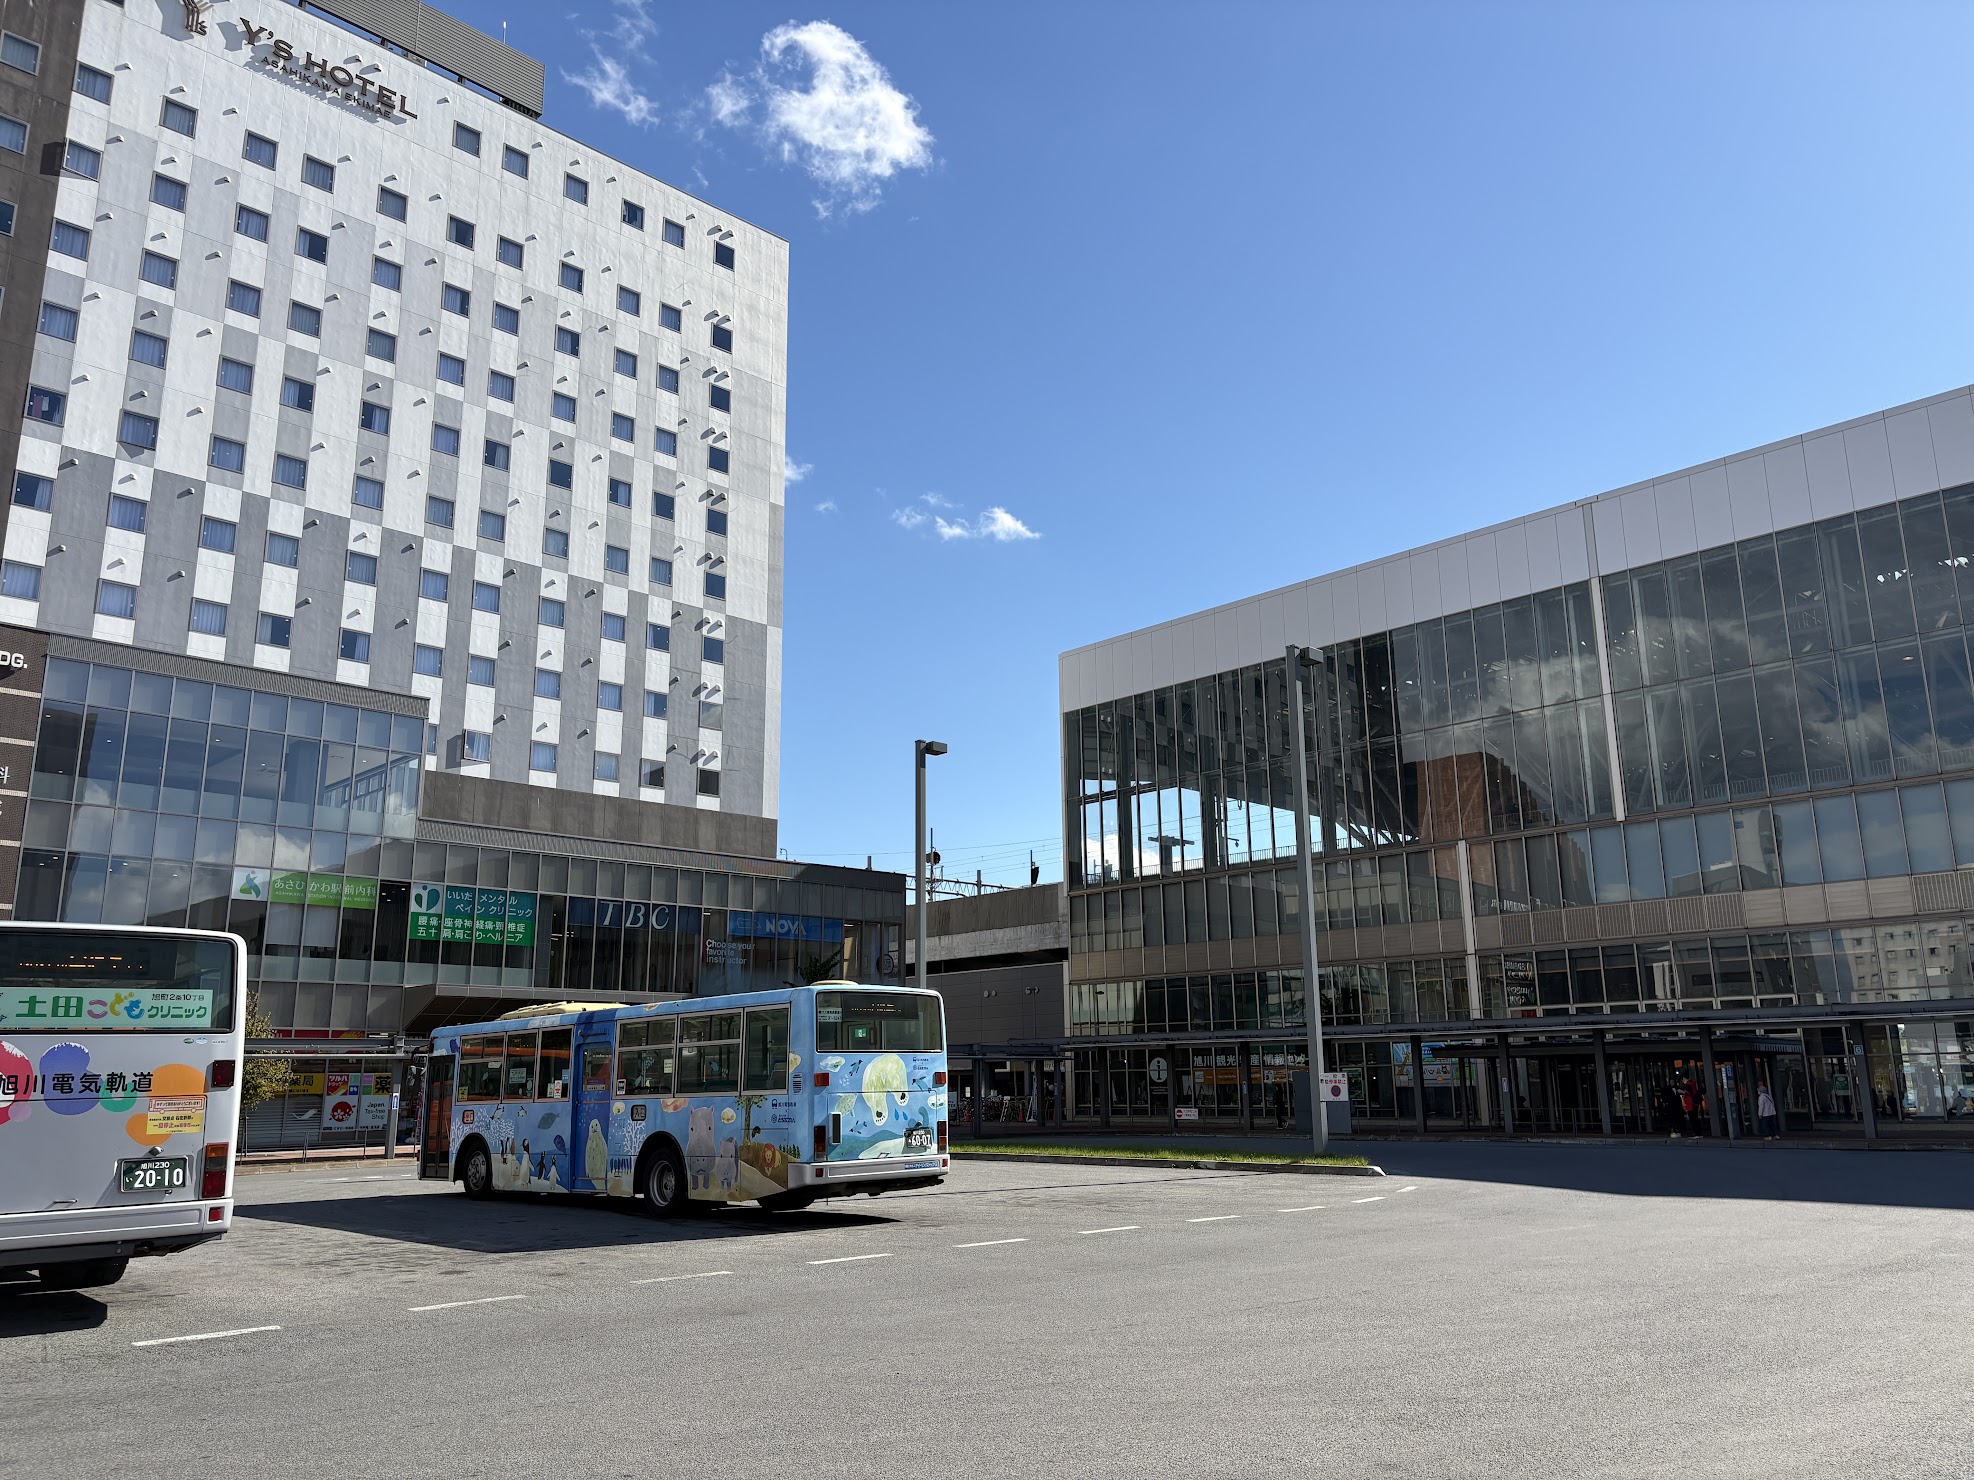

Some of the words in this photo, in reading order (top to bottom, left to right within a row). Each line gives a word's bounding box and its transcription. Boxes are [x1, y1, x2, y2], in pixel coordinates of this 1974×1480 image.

[261, 56, 340, 96] ASAHIKAWA
[344, 92, 391, 119] EKIMAE
[304, 51, 418, 120] HOTEL
[274, 879, 376, 897] あさひかわ駅前内科
[600, 900, 670, 930] TBC
[765, 918, 807, 936] NOVA
[706, 939, 737, 948] Choose
[0, 1071, 153, 1096] 旭川電気軌道
[375, 1075, 392, 1093] 薬
[911, 1134, 931, 1146] 60-07
[133, 1168, 184, 1188] 20-10
